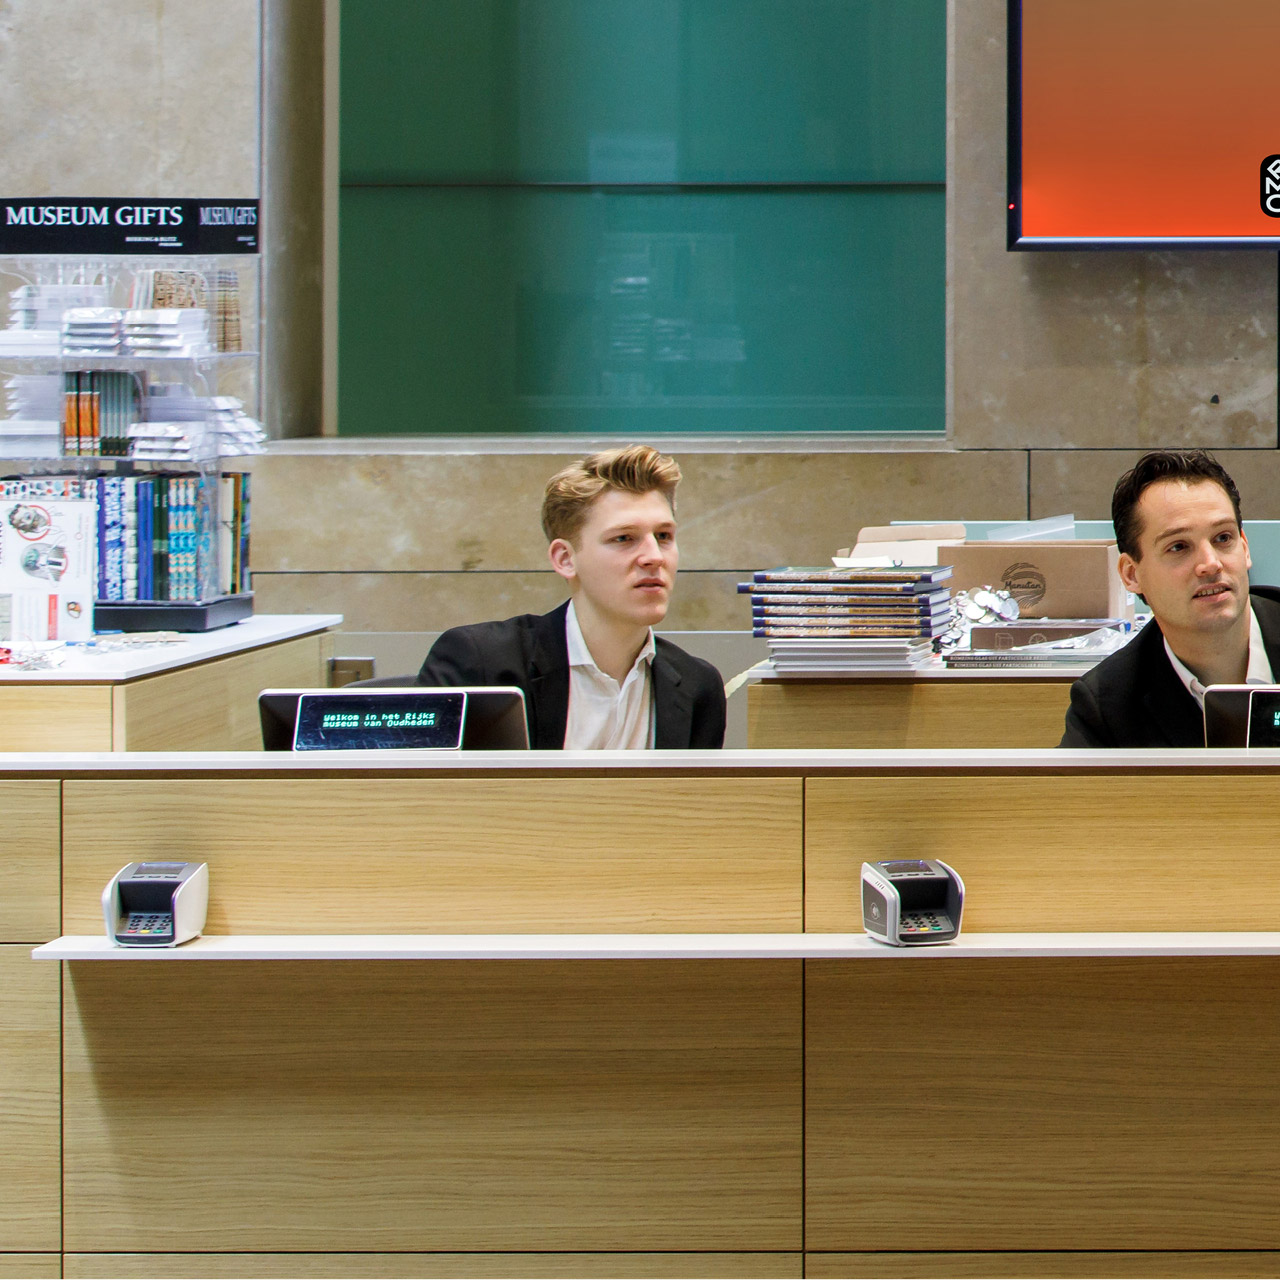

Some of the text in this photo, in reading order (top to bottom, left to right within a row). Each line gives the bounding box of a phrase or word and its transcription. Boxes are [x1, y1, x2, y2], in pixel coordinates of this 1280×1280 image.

[6, 206, 184, 226] MUSEUM GIFTS
[199, 206, 257, 226] MUSEUM GIFTS
[1004, 580, 1042, 590] Manutan
[365, 713, 377, 721] in
[405, 712, 436, 721] Rijks
[386, 719, 435, 727] Oudheden
